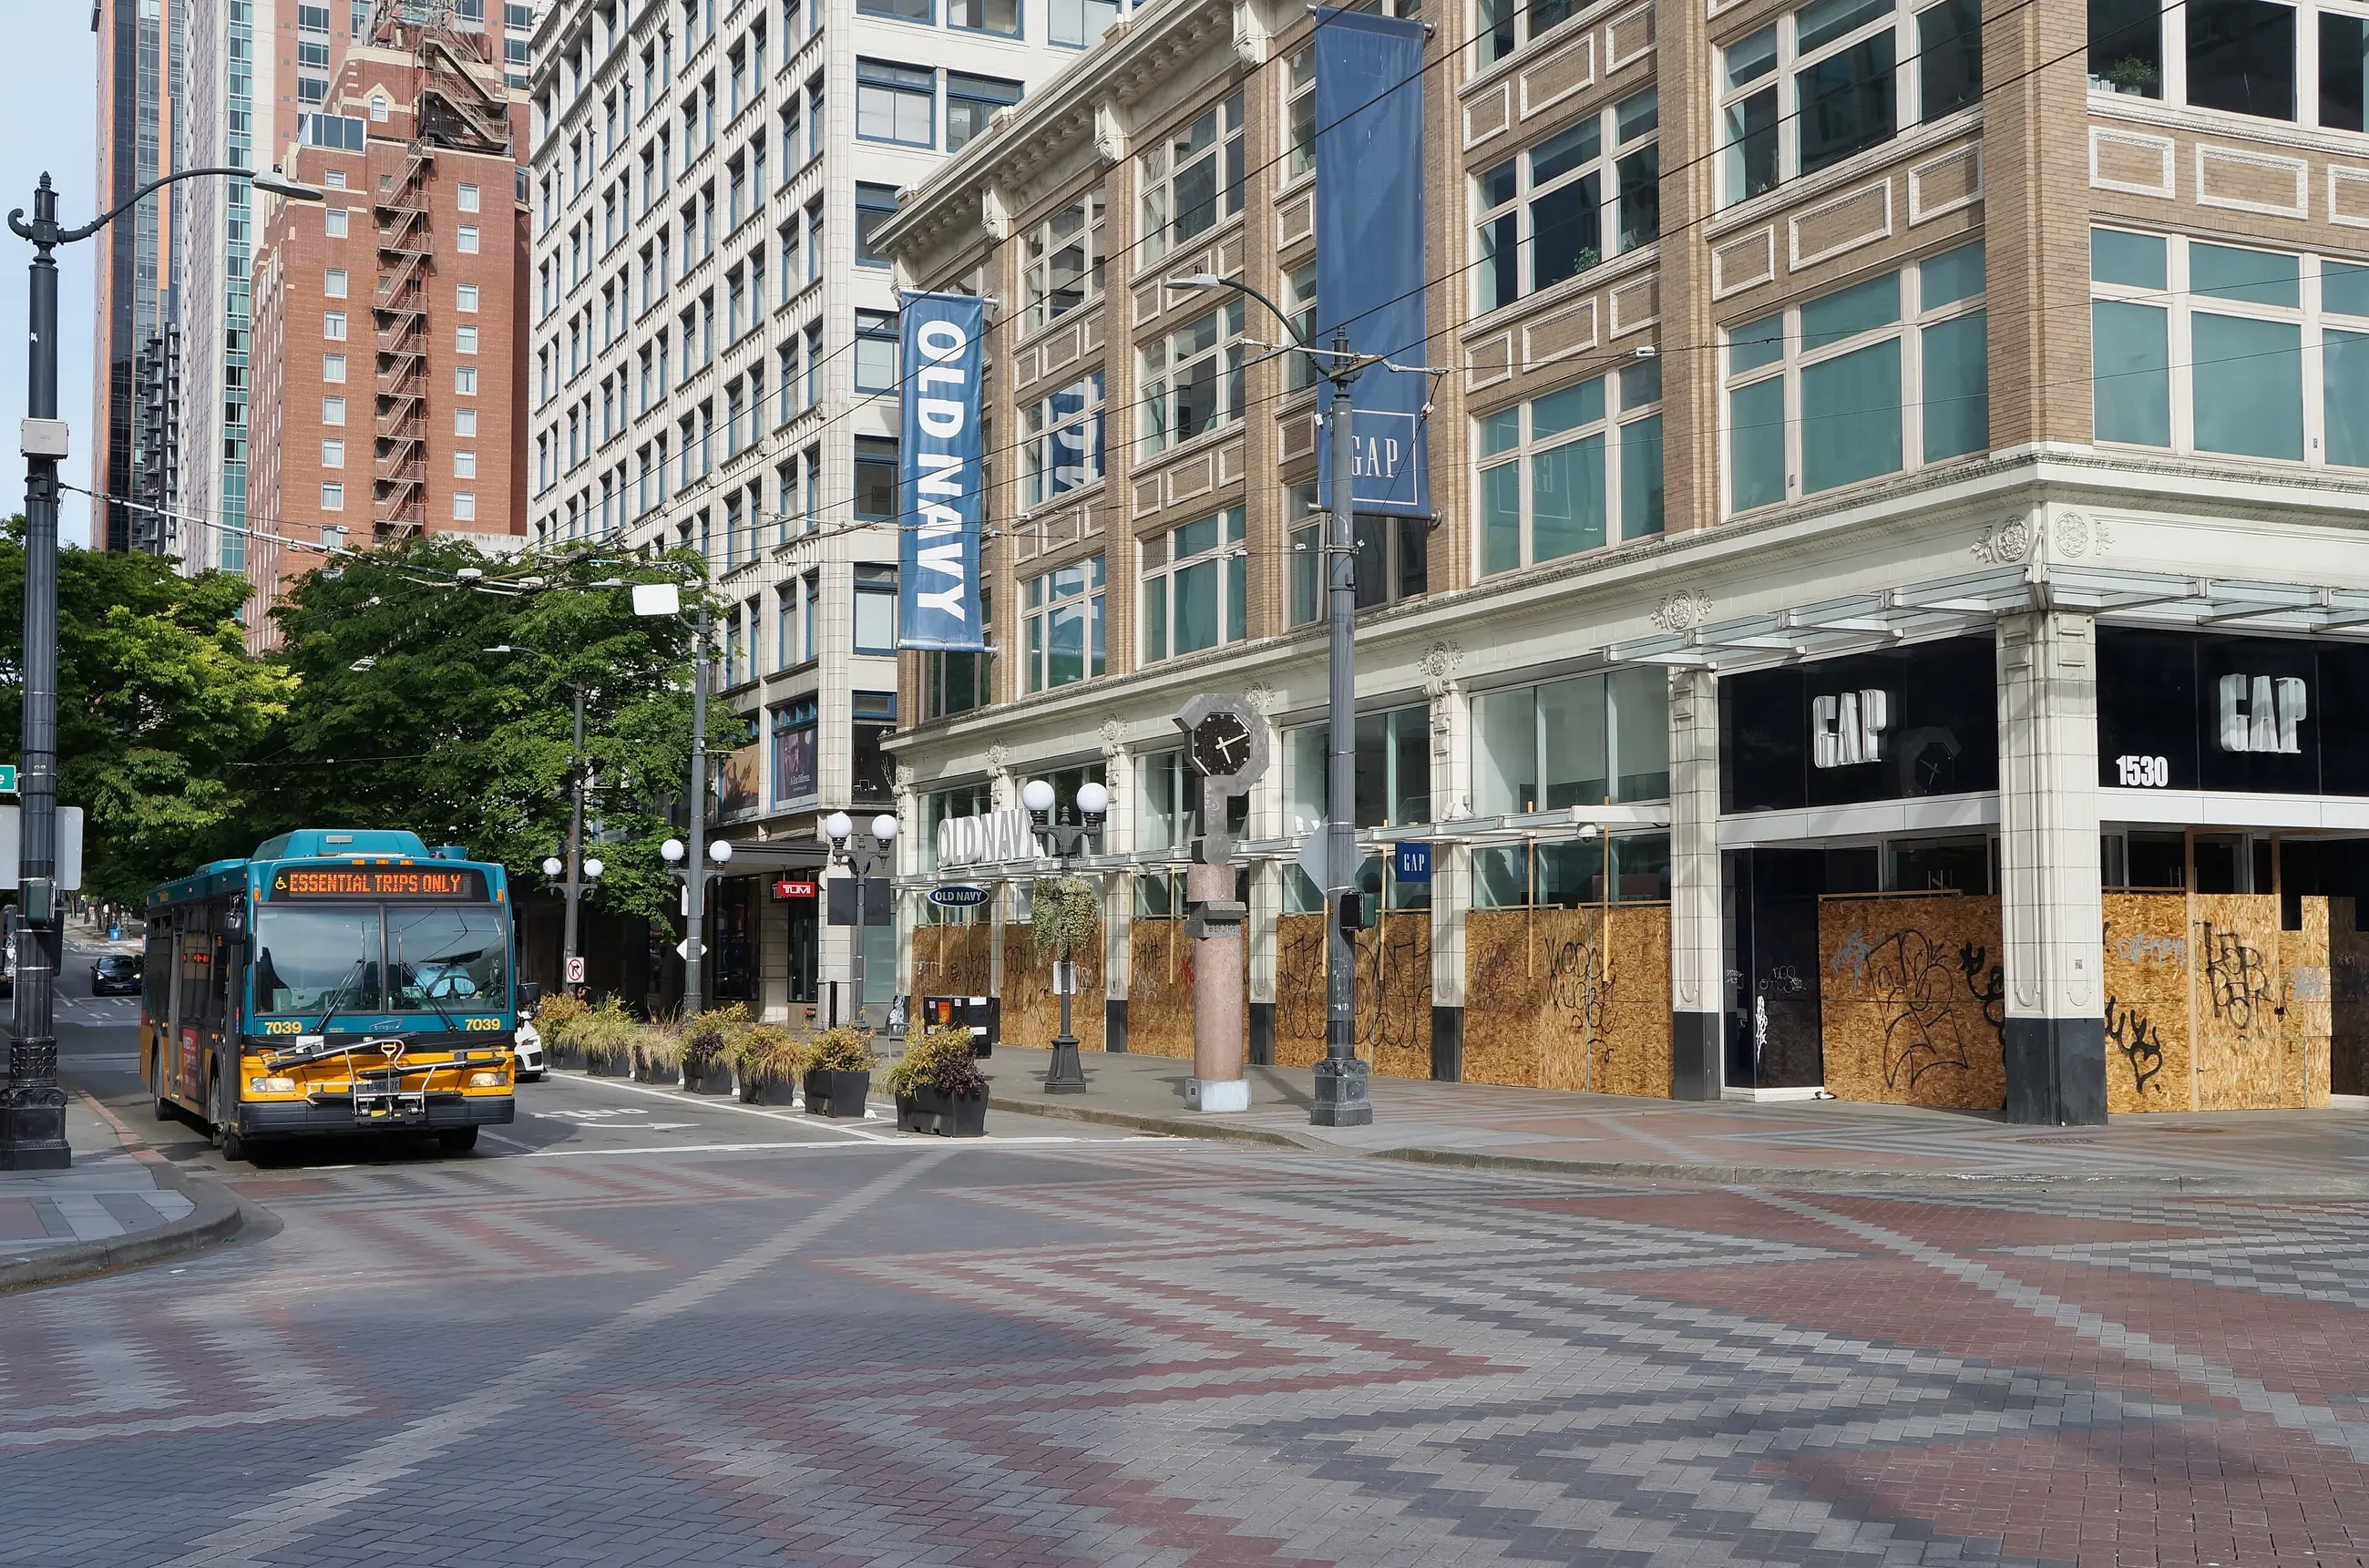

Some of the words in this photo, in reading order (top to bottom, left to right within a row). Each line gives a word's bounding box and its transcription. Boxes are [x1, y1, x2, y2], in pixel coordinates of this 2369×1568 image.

[917, 320, 967, 439] OLD
[1351, 435, 1399, 478] GAP
[917, 453, 966, 623] NAVY
[1812, 689, 1887, 768] GAP
[2220, 672, 2307, 753] GAP
[2116, 754, 2169, 787] 1530
[937, 815, 981, 867] OLD
[1403, 853, 1425, 872] GAP
[290, 873, 371, 893] ESSENTIAL
[374, 874, 418, 893] TRIPS
[422, 874, 462, 893] ONLY
[783, 885, 810, 894] TUMI
[935, 891, 955, 901] OLD
[956, 891, 982, 901] NAVY
[264, 1021, 303, 1034] 7039
[465, 1018, 501, 1031] 7039
